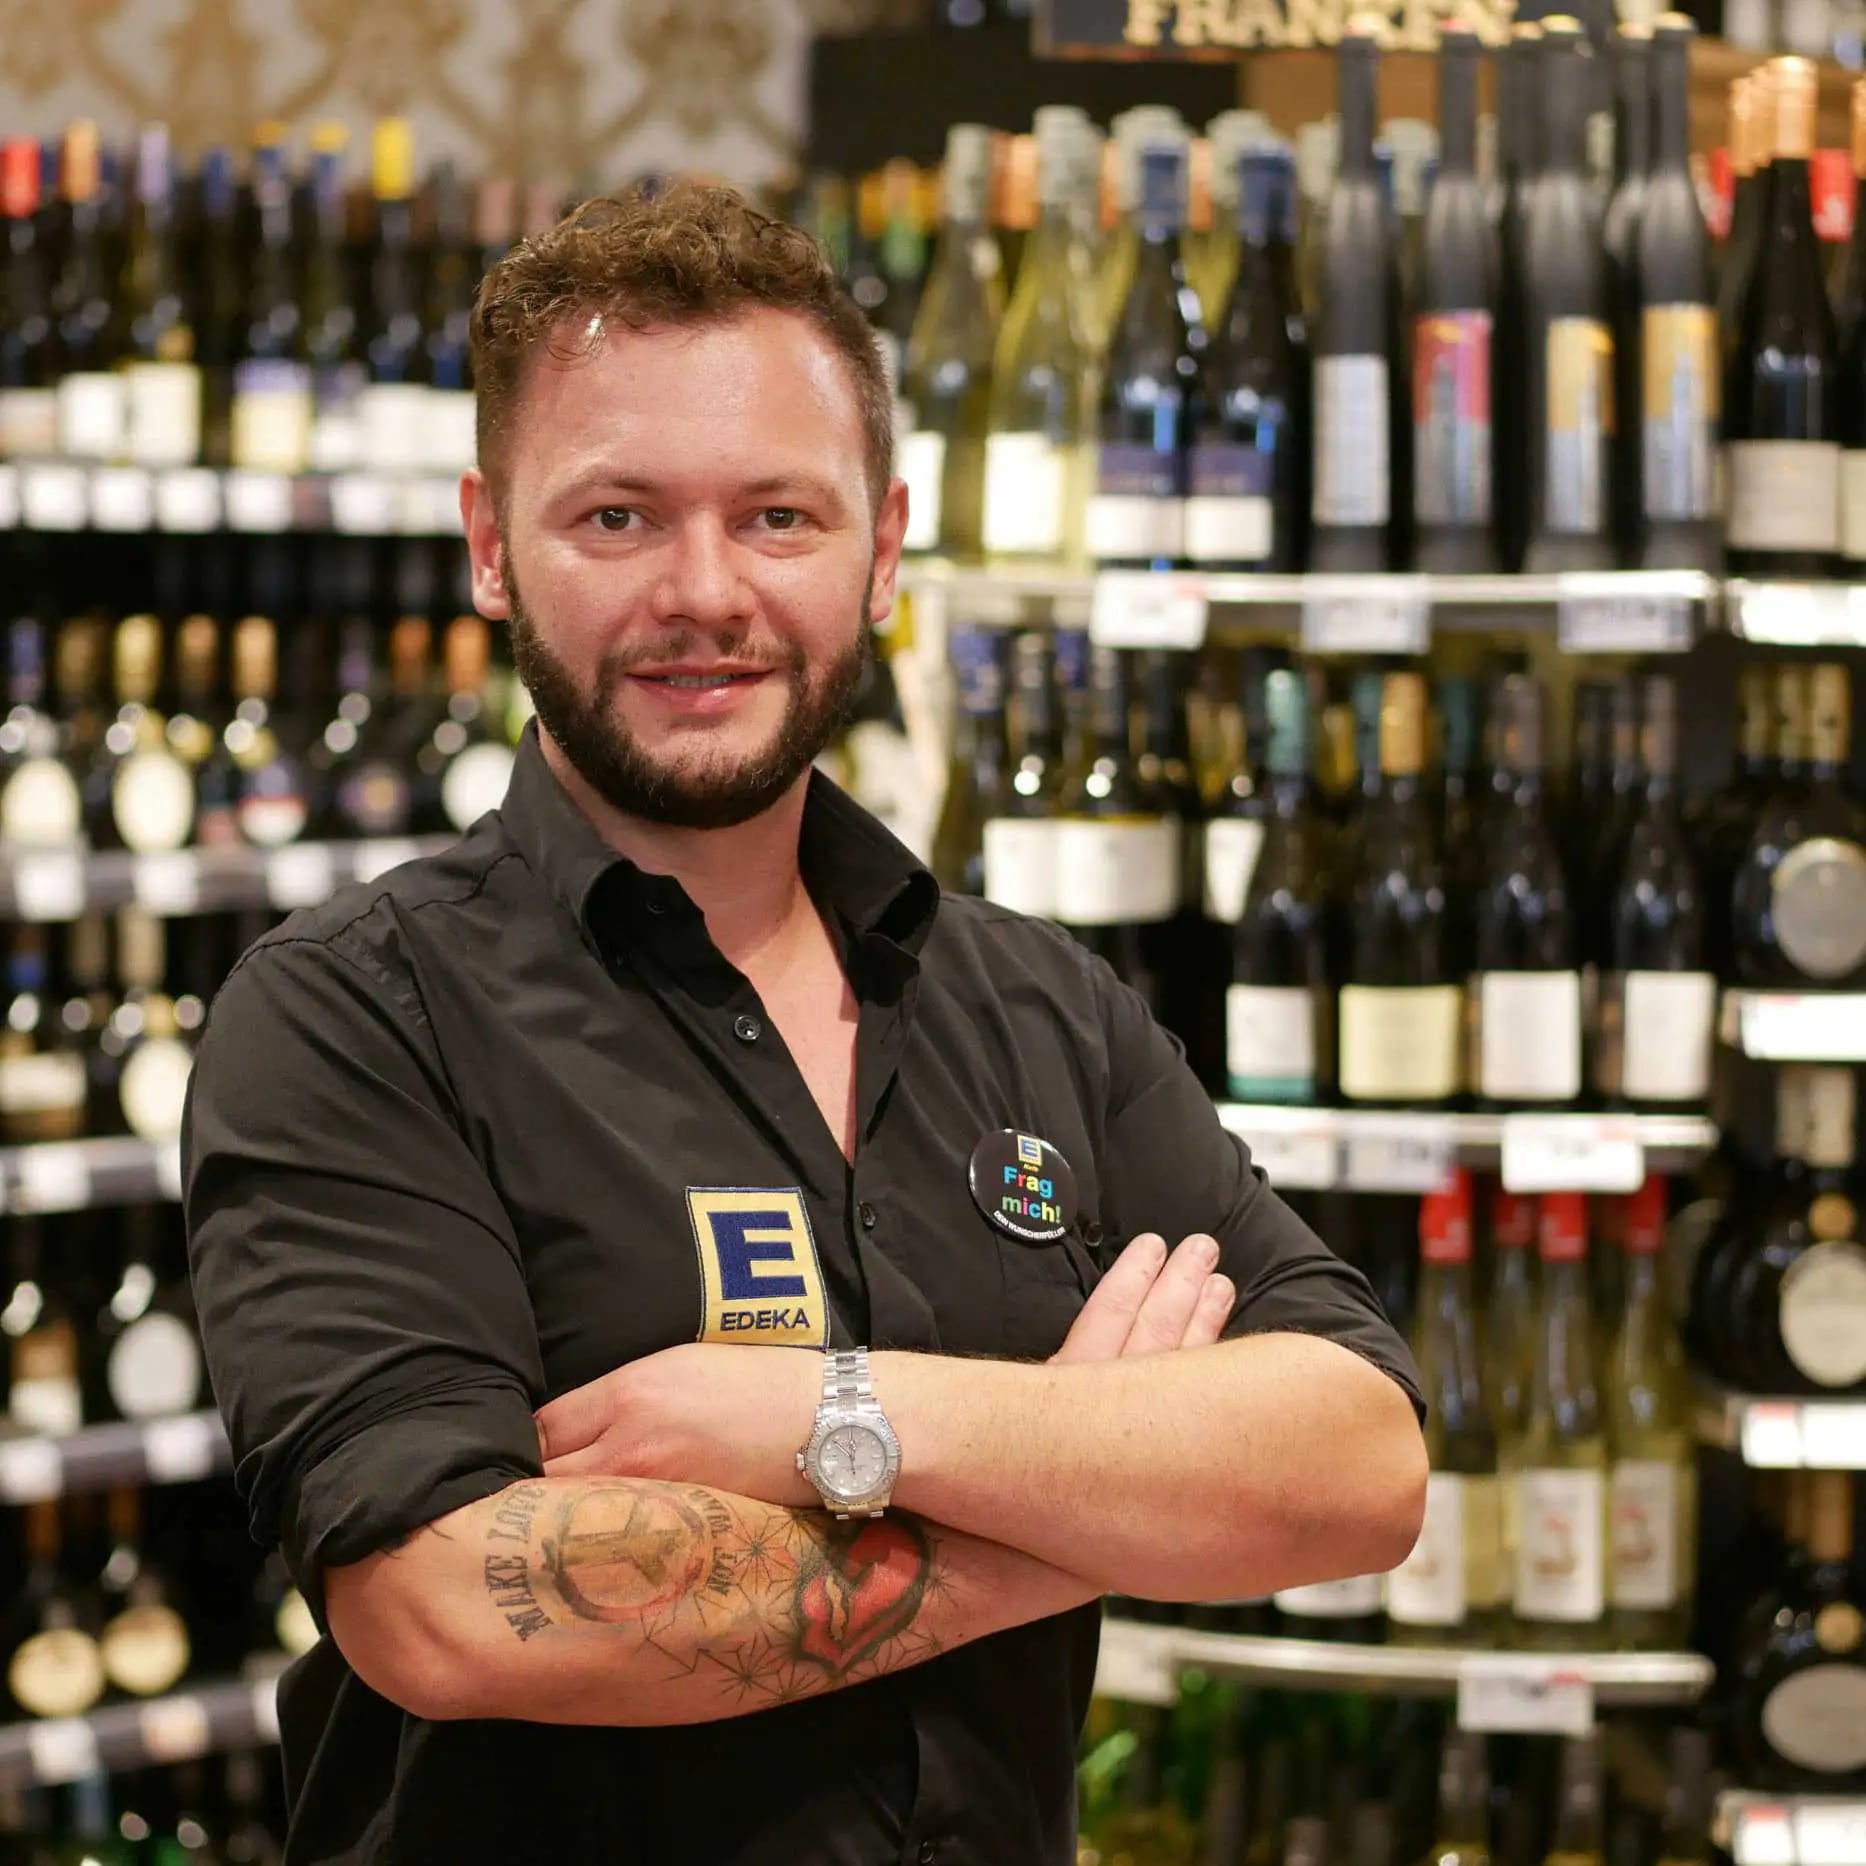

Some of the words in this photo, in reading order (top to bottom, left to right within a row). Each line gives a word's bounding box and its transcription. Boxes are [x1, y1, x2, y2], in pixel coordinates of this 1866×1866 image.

[1003, 1166, 1052, 1199] Frag
[1002, 1197, 1061, 1224] mich!
[706, 1210, 808, 1301] E
[720, 1308, 811, 1331] EDEKA
[706, 1546, 739, 1598] NOT
[484, 1554, 555, 1642] MAKE
